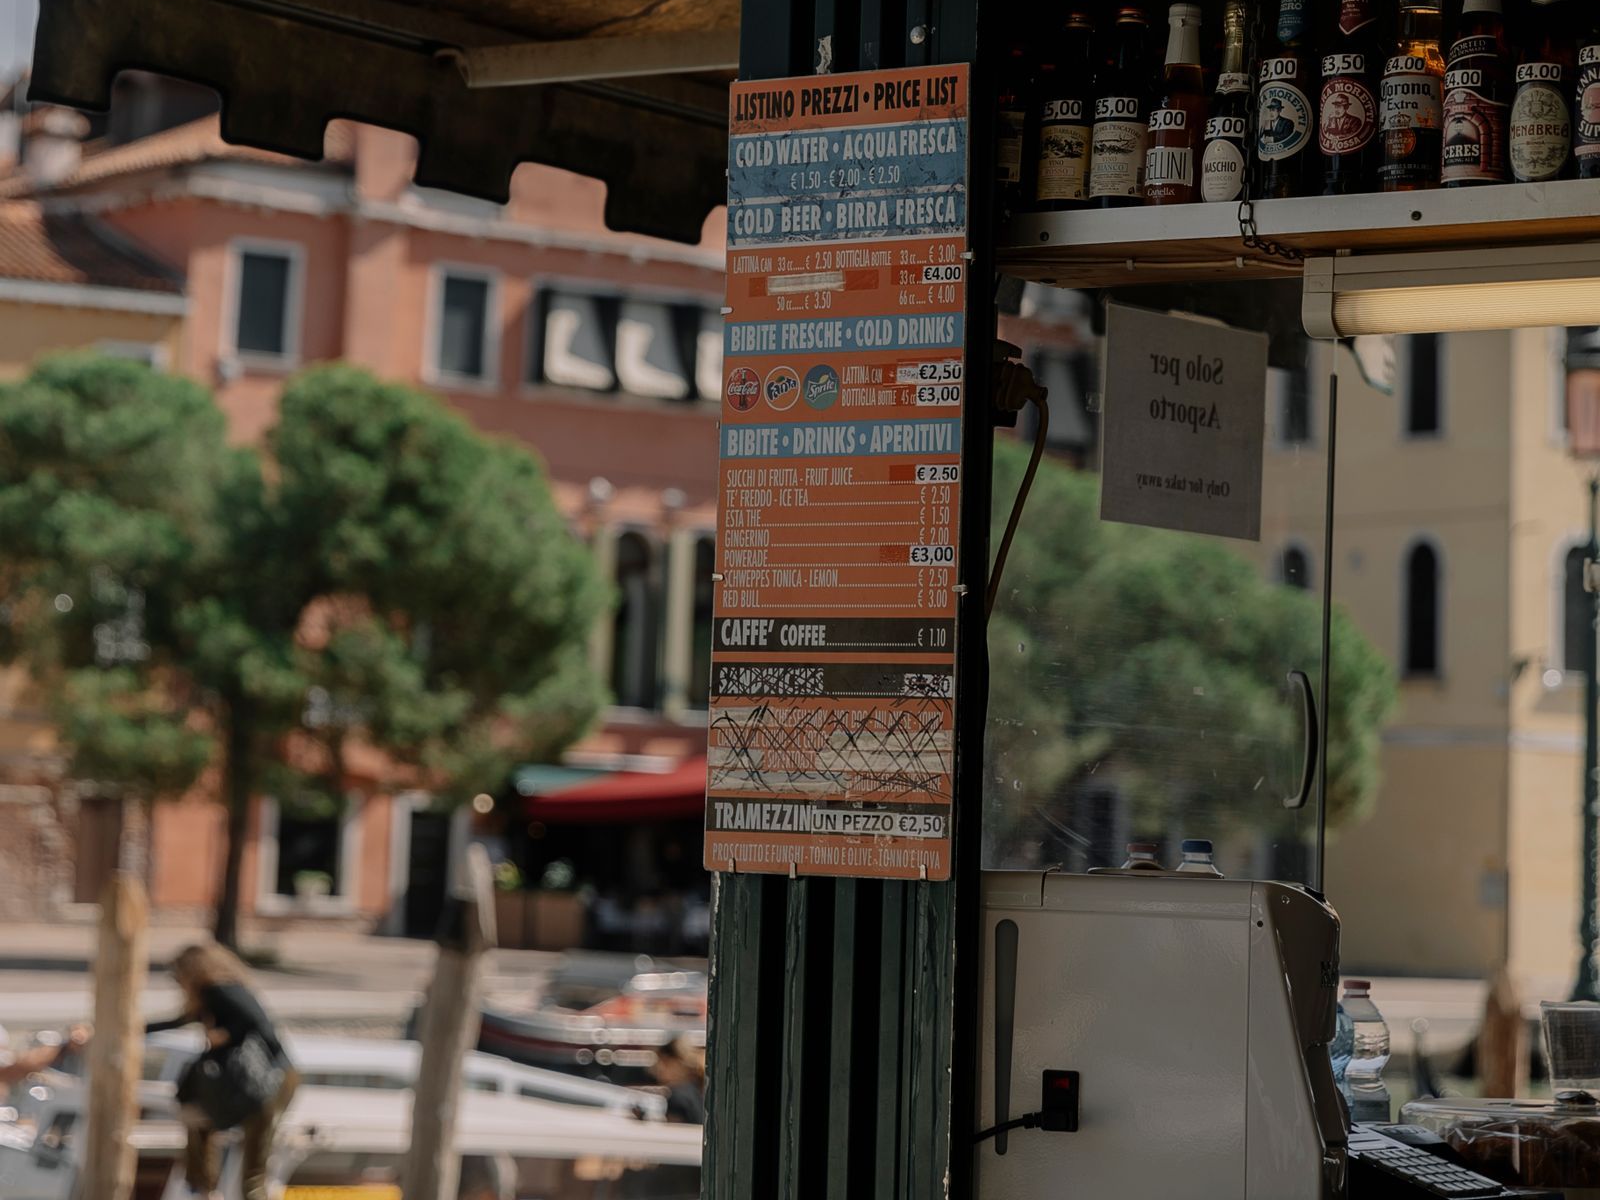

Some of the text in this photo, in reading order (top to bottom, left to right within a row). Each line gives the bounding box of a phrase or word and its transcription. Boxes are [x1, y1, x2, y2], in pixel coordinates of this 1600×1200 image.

[1260, 59, 1296, 79] 3,00
[1322, 54, 1364, 73] €3,50
[1386, 57, 1424, 73] €4.00
[1517, 64, 1560, 80] €4.00
[736, 76, 958, 121] LISTINO PREZZI PRICE LIST
[1380, 81, 1432, 102] Corona
[1044, 100, 1081, 119] 5,00
[1096, 98, 1137, 116] €5,00
[1269, 89, 1307, 128] MORETTI
[1334, 83, 1375, 124] MORETTI
[1387, 98, 1418, 111] Extra
[1511, 123, 1569, 140] MENABREA
[735, 126, 957, 168] COLD WATER ACQUA FRESCA
[1444, 144, 1480, 159] CERES
[1204, 161, 1237, 173] MASCHIO
[734, 196, 957, 236] COLD BEER BIRRA FRESCA
[733, 255, 760, 274] LATTINA
[761, 257, 773, 273] CAN
[835, 249, 870, 269] BOTTIGLIA
[871, 250, 892, 266] BOTTLE
[924, 266, 961, 281] €4.00
[731, 315, 955, 351] BIBITE FRESCHE COLD DRINKS
[842, 365, 883, 384] LATTINA CAN
[920, 364, 961, 383] €2,50
[766, 377, 797, 402] Fanta
[808, 379, 835, 399] Sprite
[841, 387, 876, 407] BOTTIGLIA
[878, 390, 897, 406] BOTTLE
[918, 386, 960, 405] €3,00
[727, 423, 952, 456] BIBITE DRINKS APERITIVI
[727, 468, 756, 487] SUCCHI
[758, 468, 767, 487] DI
[769, 468, 798, 487] FRUTTA
[805, 467, 829, 486] FRUIT
[830, 467, 853, 486] JUICE
[740, 489, 773, 507] FREDDO
[779, 489, 792, 507] ICE
[794, 488, 809, 506] TEA
[725, 509, 744, 528] ESTA
[746, 509, 762, 527] THE
[725, 529, 770, 548] GINGERINO
[724, 545, 954, 568] POWERADE €3,00
[723, 569, 770, 588] SCHWEPPES
[772, 569, 802, 588] TONICA
[809, 569, 839, 588] LEMON
[723, 591, 738, 608] RED
[740, 590, 761, 608] BULL
[780, 624, 827, 647] COFFEE
[929, 628, 947, 647] 1.10
[714, 802, 817, 832] TRAMEZZIN
[813, 813, 943, 834] UN PEZZO €2,50
[712, 843, 764, 863] PROSCIUTTO
[771, 843, 804, 865] FUNGHI
[809, 845, 839, 866] TONNO
[848, 846, 873, 867] OLIVE
[878, 848, 909, 869] TONNO
[916, 849, 941, 870] UOVA
